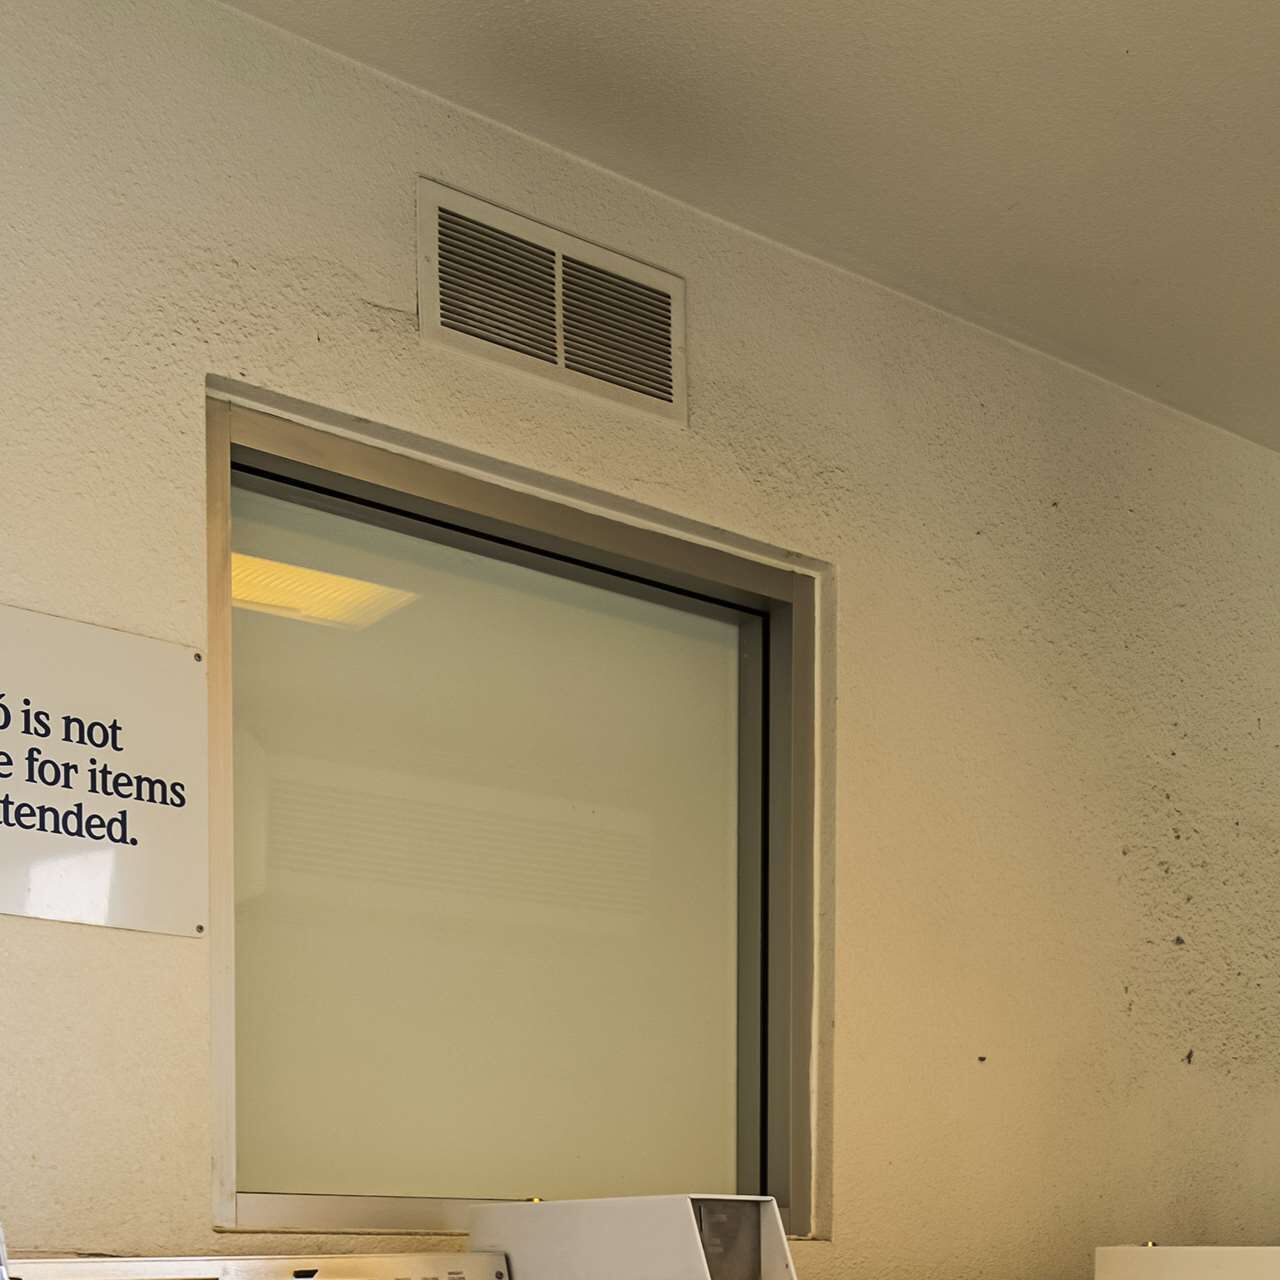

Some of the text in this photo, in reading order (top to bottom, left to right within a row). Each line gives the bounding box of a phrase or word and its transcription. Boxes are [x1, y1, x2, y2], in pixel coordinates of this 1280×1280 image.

[20, 698, 51, 738] is
[61, 714, 124, 752] not
[24, 747, 79, 790] for
[87, 758, 187, 809] items
